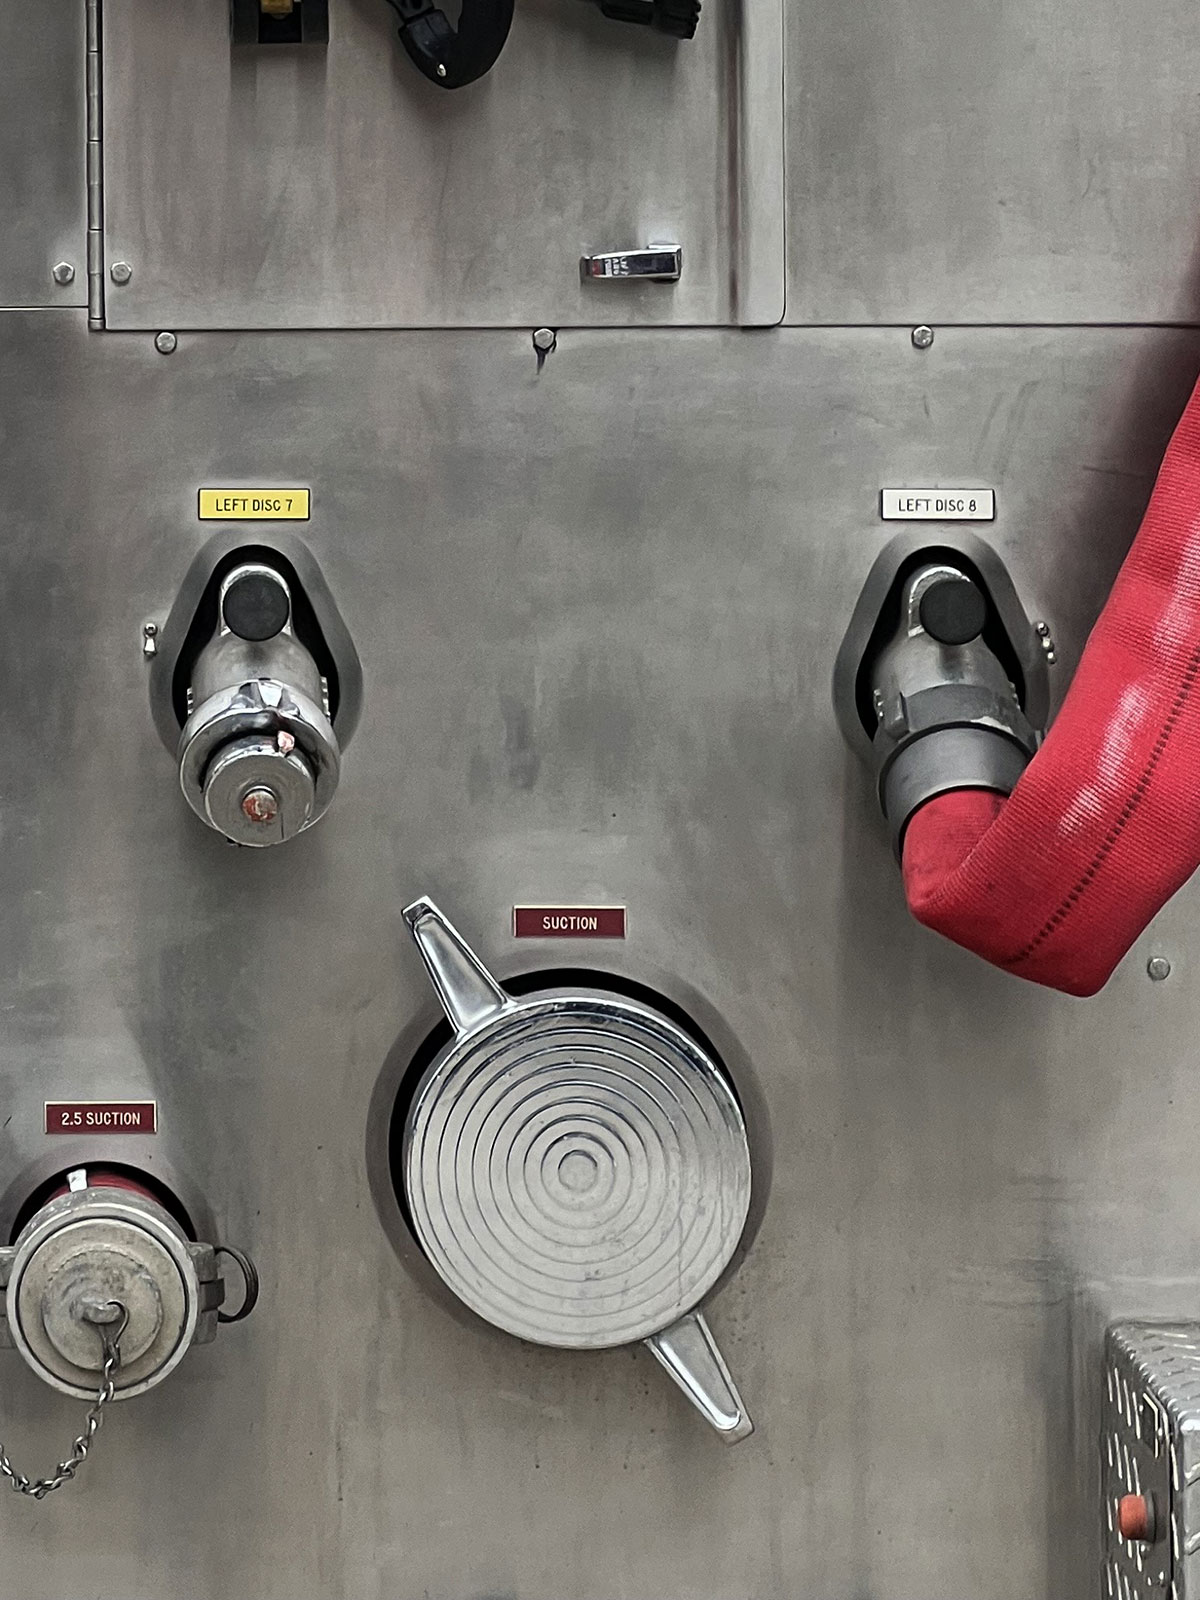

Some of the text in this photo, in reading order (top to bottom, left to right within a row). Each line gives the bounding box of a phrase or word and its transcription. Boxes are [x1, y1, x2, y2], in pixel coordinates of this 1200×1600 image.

[216, 498, 293, 512] LEFT DISC 7
[898, 498, 977, 512] LEFT DISC 8
[543, 916, 597, 930] SUCTION
[61, 1112, 140, 1126] 2.5 SUCTION
